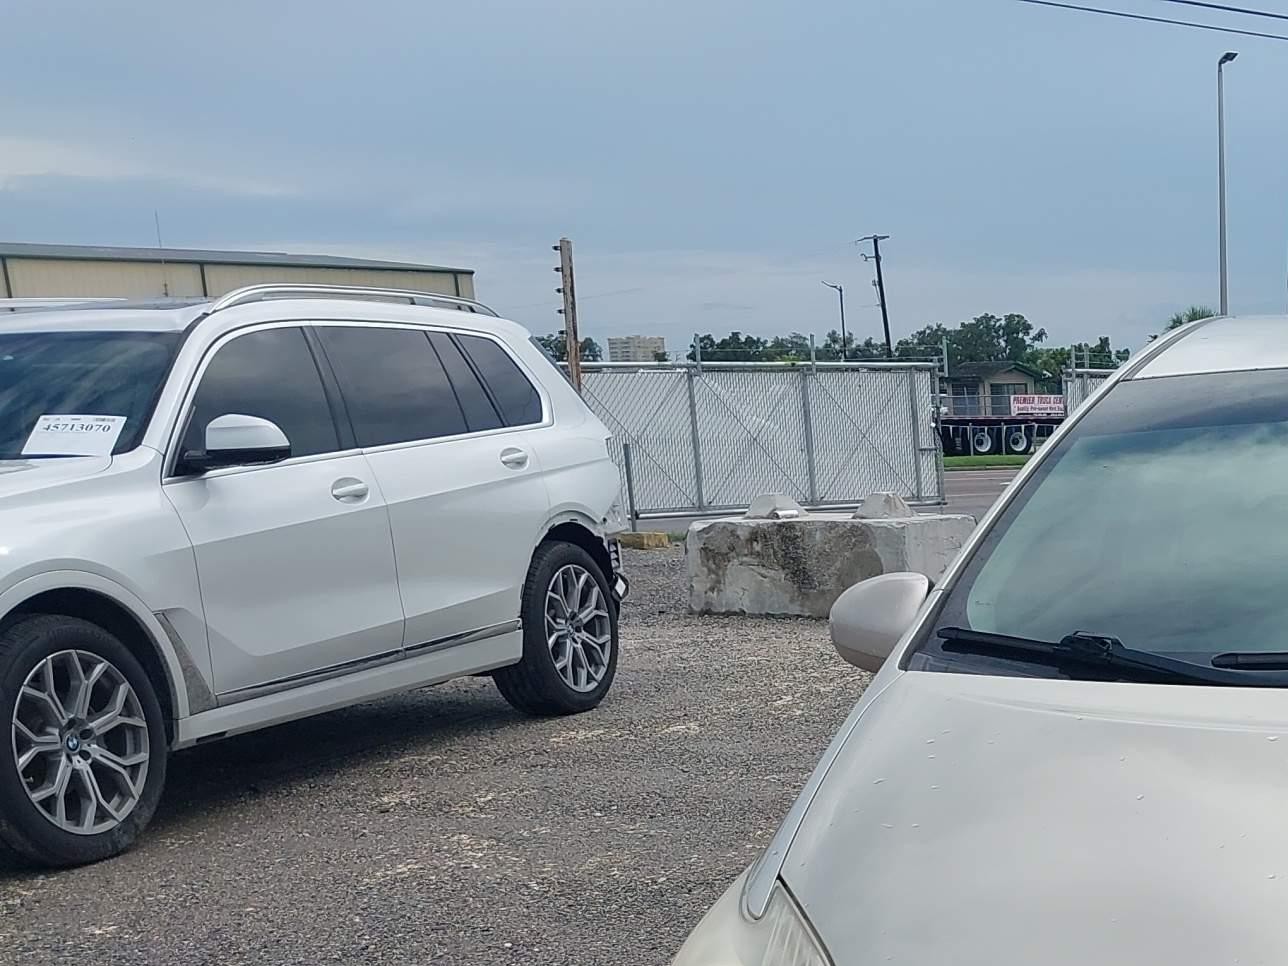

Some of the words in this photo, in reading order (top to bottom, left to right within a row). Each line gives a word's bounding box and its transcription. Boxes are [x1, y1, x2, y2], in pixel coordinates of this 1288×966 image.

[1013, 397, 1035, 405] PREMIER
[1053, 397, 1064, 405] CEN
[43, 423, 111, 432] 45713070
